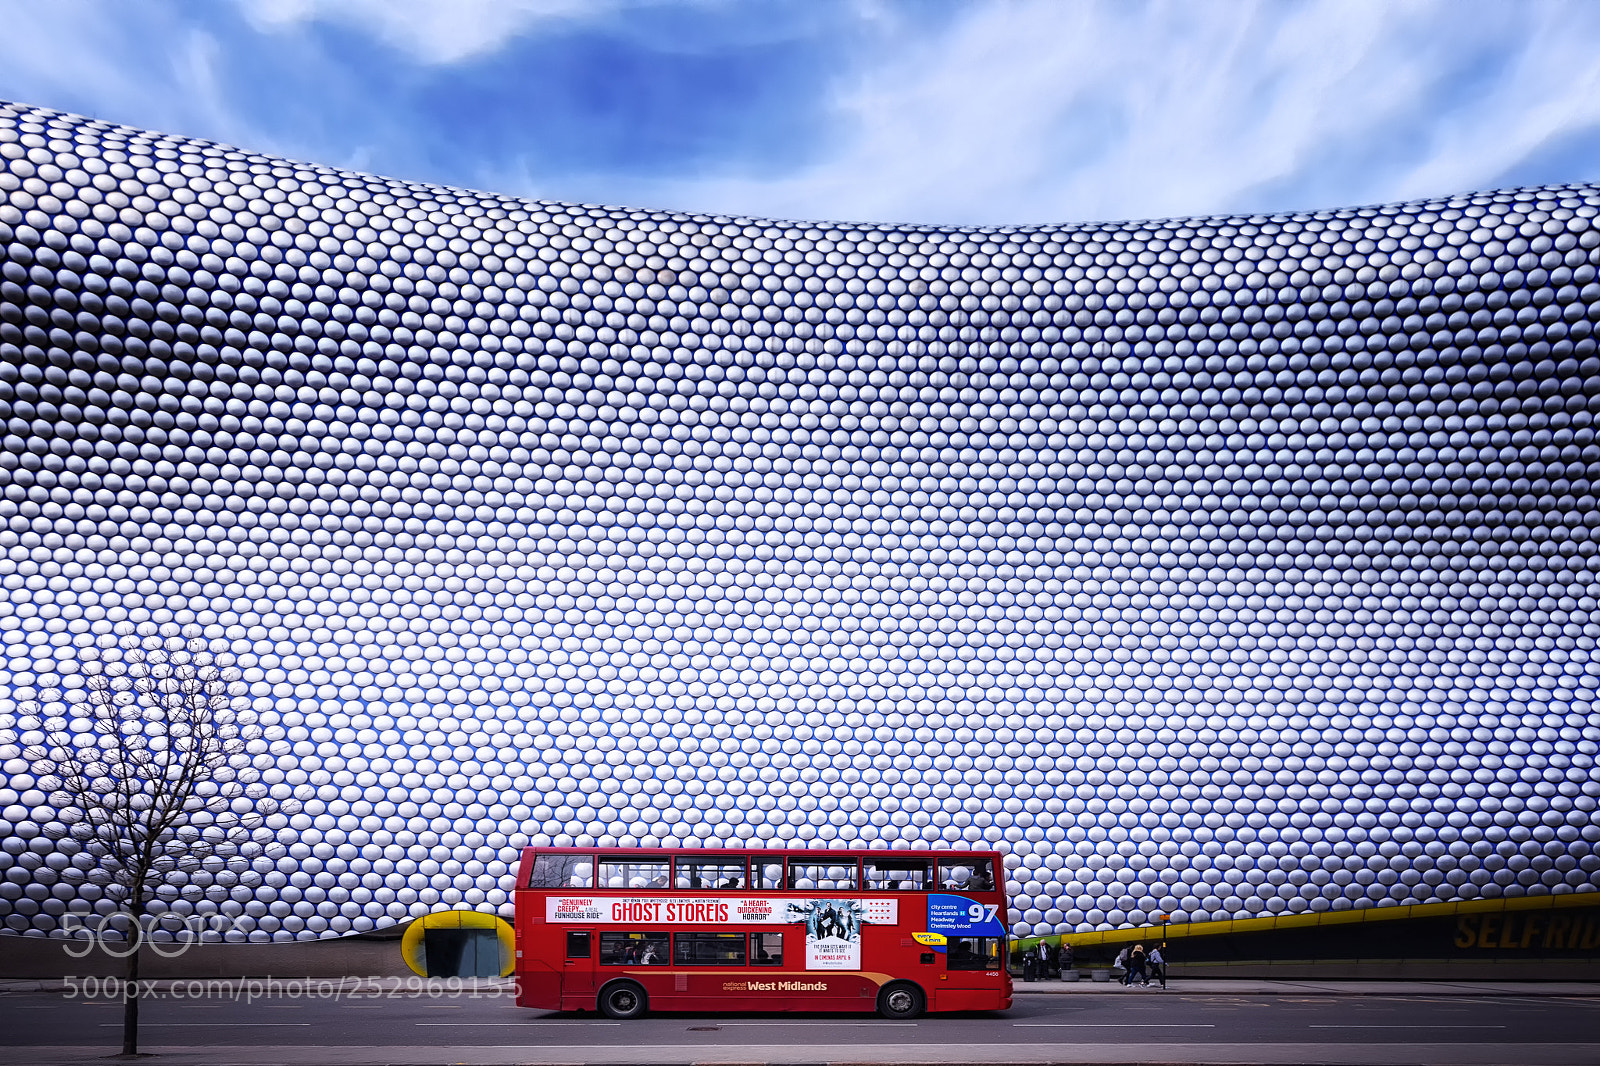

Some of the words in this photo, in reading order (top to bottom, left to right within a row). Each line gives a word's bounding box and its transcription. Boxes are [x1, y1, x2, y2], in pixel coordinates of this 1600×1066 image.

[612, 903, 662, 921] GHOST
[666, 903, 729, 922] STOREIS
[968, 904, 999, 923] 97
[747, 981, 776, 991] West
[778, 981, 828, 991] Midlands
